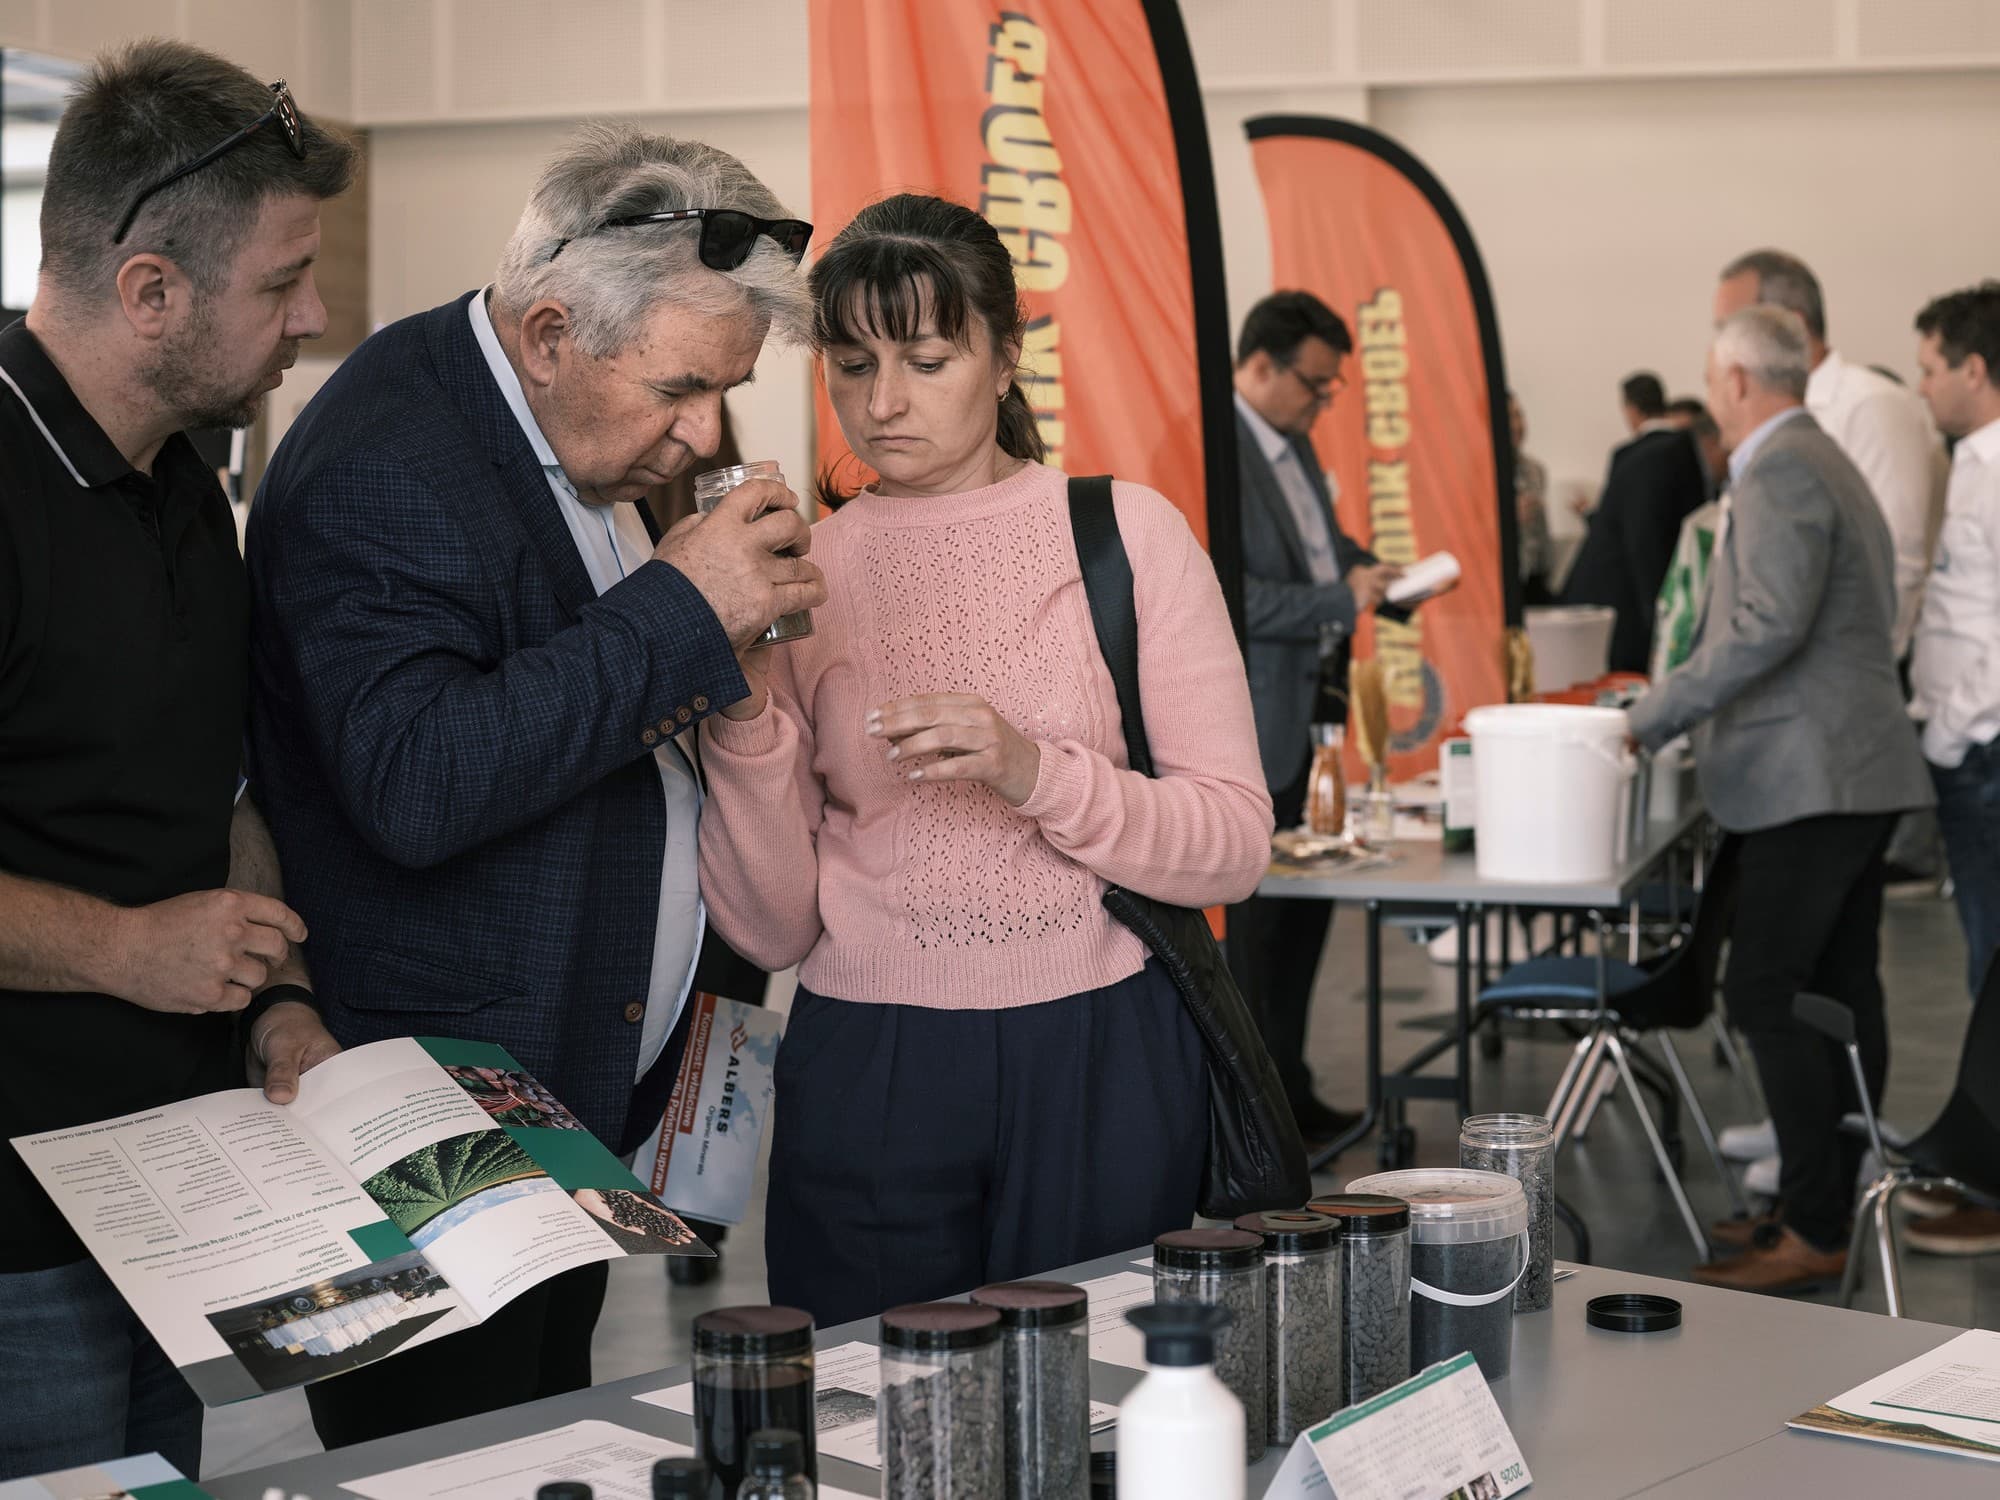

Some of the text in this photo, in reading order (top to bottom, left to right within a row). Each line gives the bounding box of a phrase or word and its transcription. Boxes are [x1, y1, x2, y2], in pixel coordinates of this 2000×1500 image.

[692, 1012, 711, 1069] Kompost:
[681, 1071, 700, 1127] właściwe
[716, 1055, 740, 1133] ALBERS
[660, 1099, 678, 1150] Państwa
[695, 1105, 716, 1175] Organic Minerals
[651, 1152, 667, 1190] upraw
[1501, 1463, 1523, 1484] 2026
